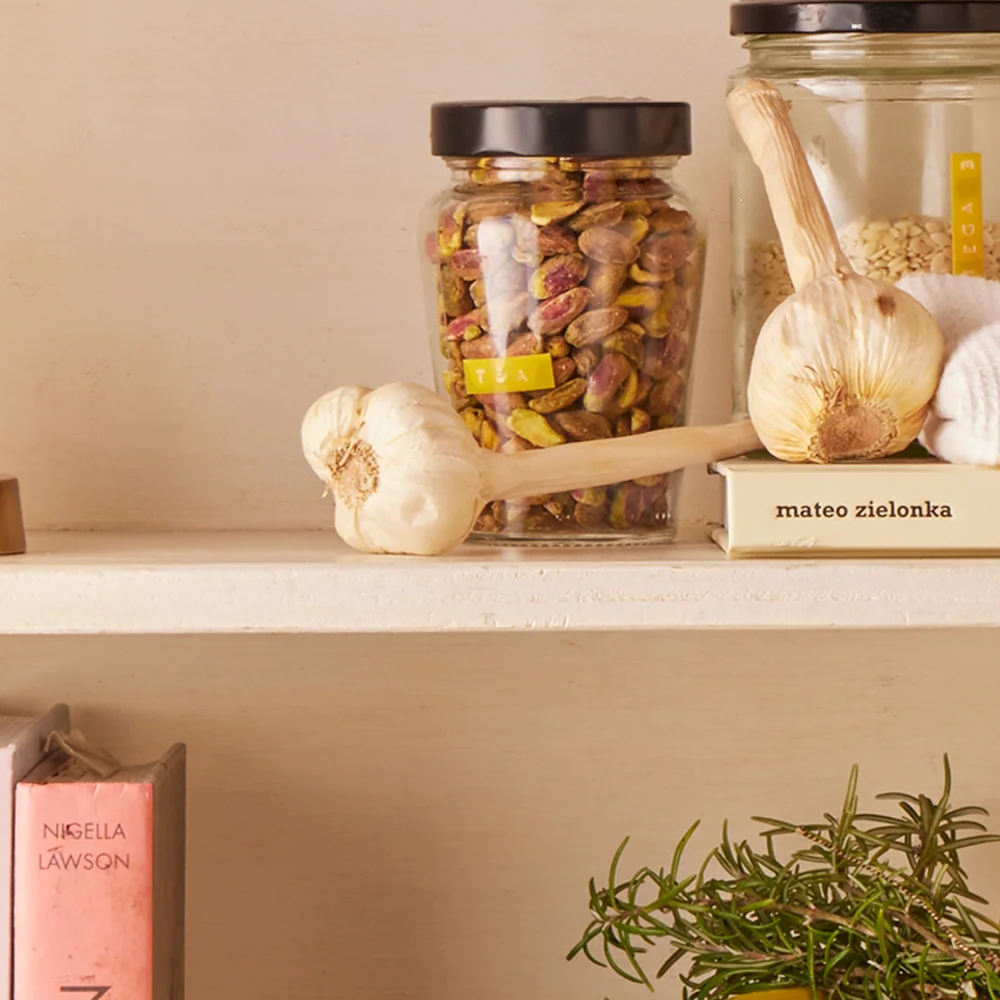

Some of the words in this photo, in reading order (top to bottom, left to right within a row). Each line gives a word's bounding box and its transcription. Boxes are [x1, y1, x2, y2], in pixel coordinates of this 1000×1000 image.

[776, 501, 849, 518] mateo
[855, 500, 953, 518] zielonka
[43, 822, 126, 840] NIGELLA
[38, 852, 130, 871] LAWSON
